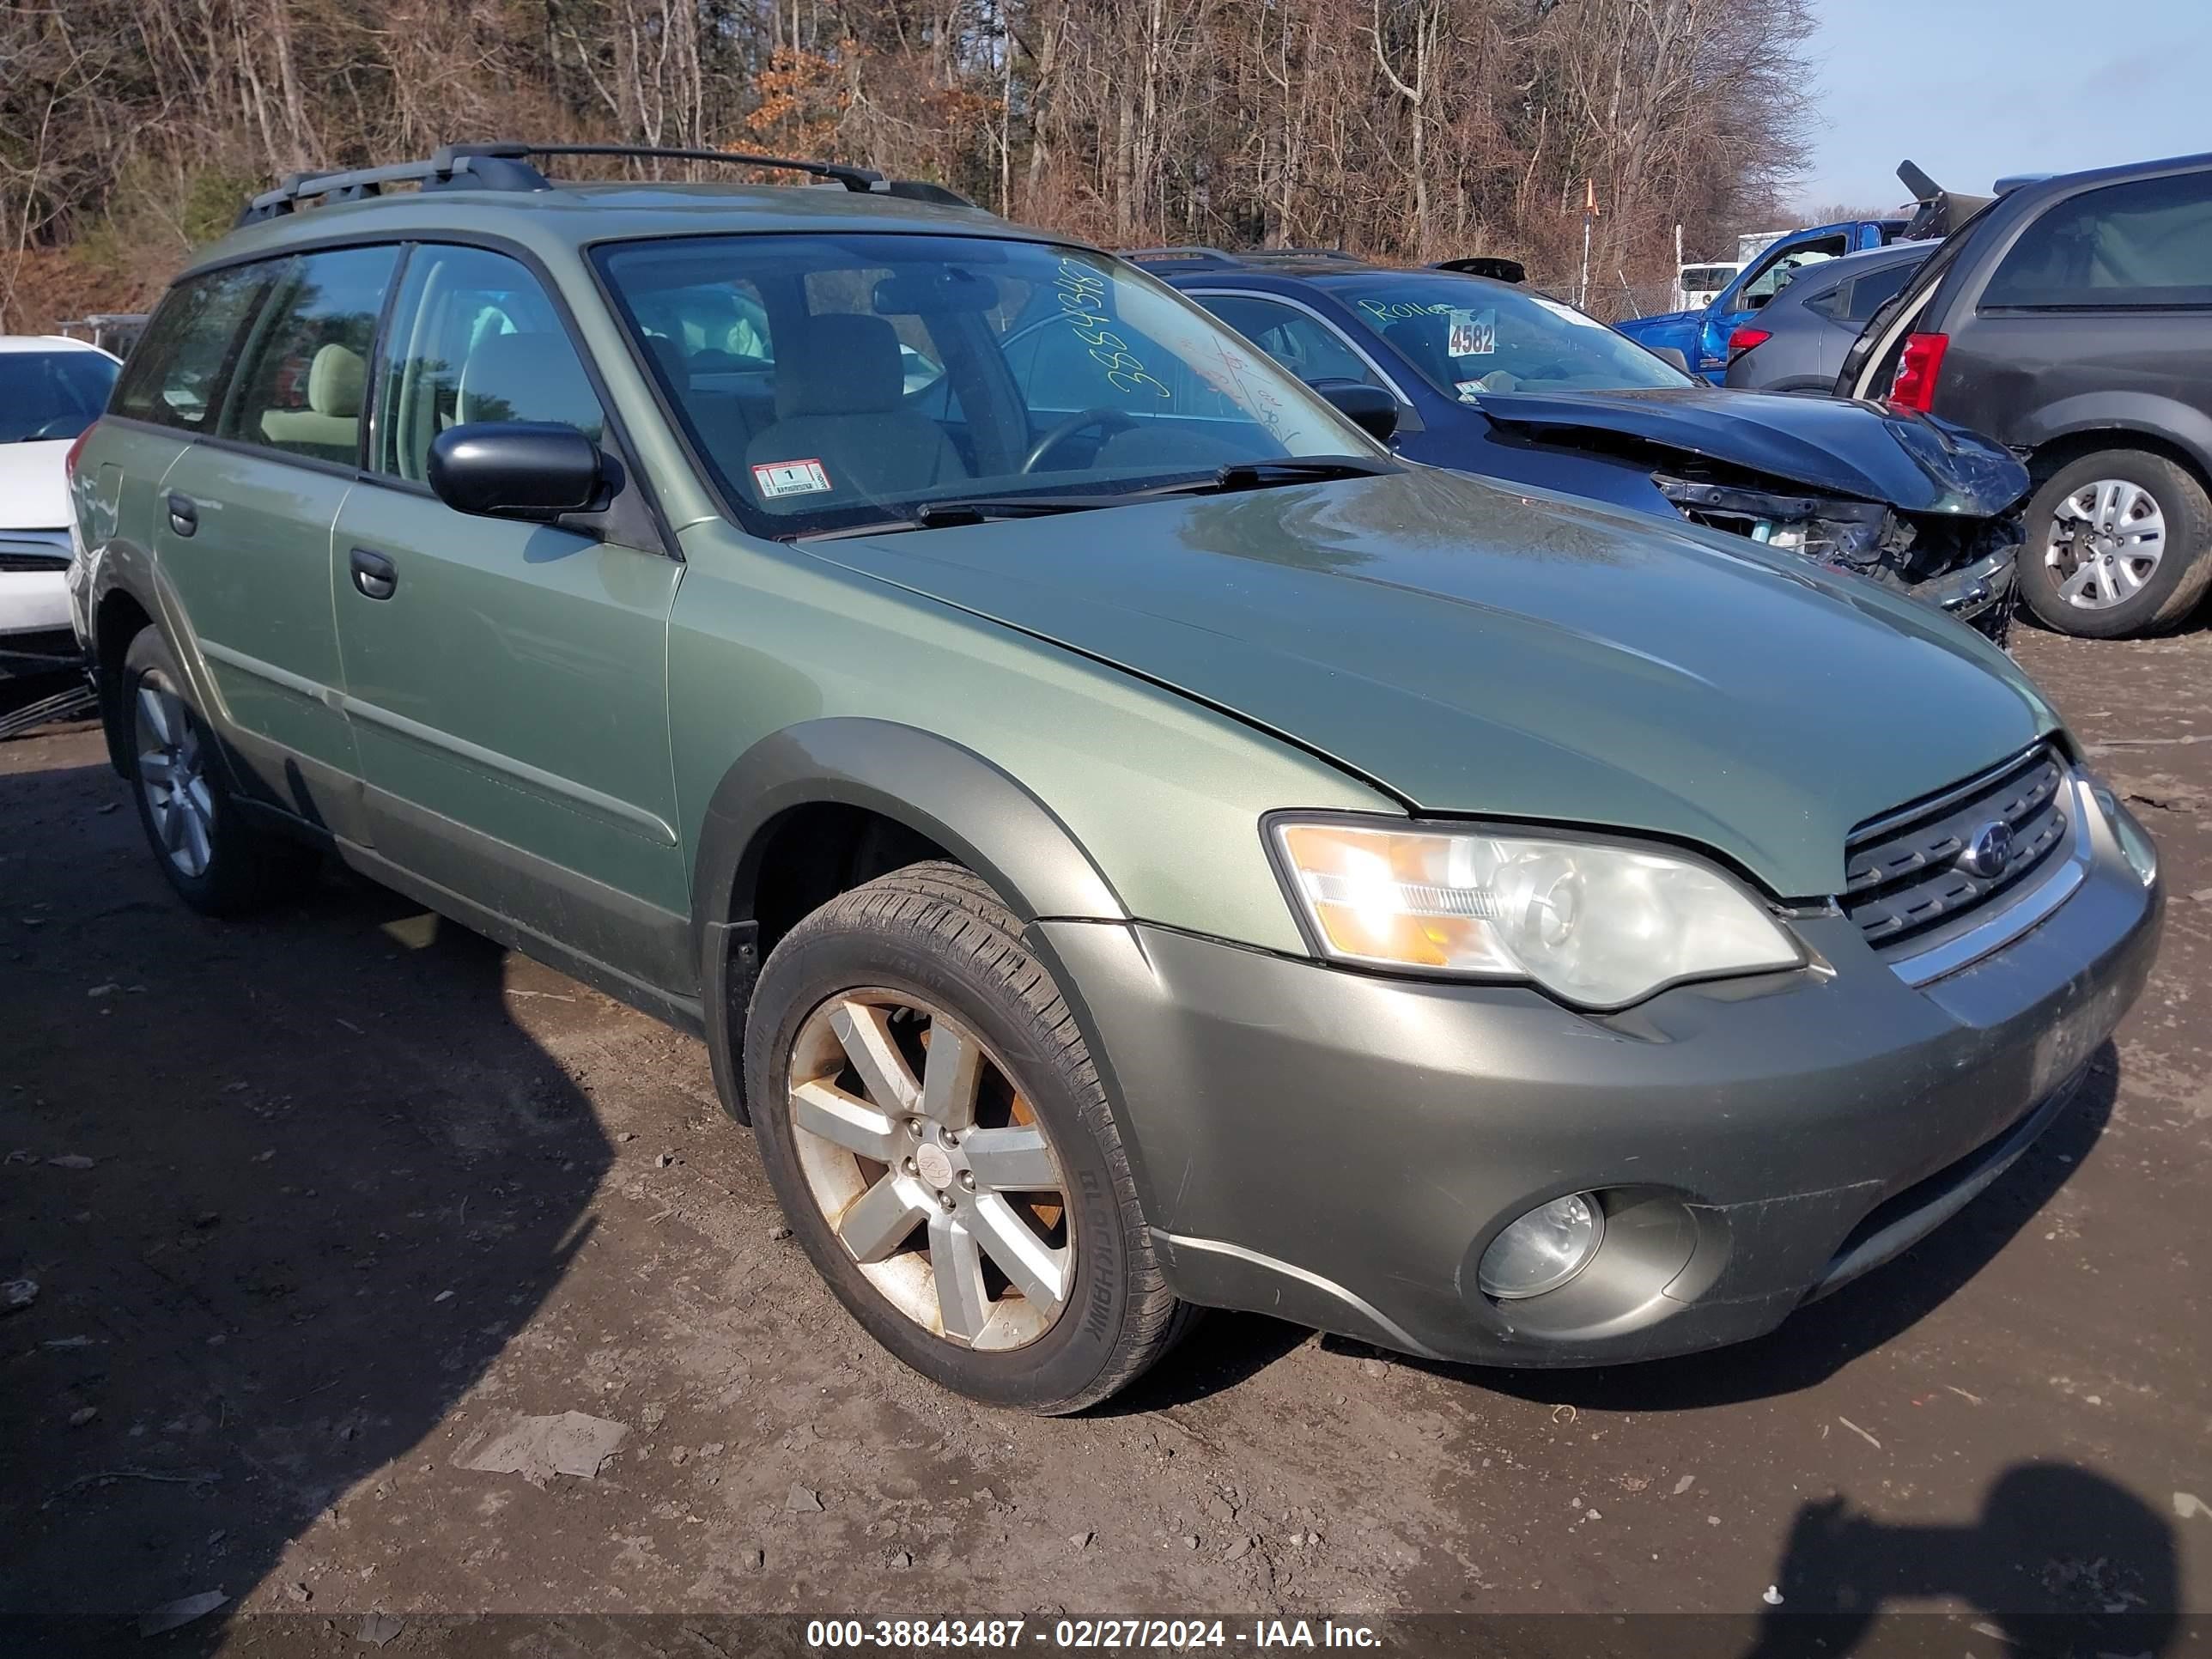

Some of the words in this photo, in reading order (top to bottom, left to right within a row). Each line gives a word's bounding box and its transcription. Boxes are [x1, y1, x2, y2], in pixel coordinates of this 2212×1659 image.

[1449, 325, 1493, 353] 4582
[784, 470, 793, 480] 1
[1079, 1170, 1114, 1342] BLACKHAWK
